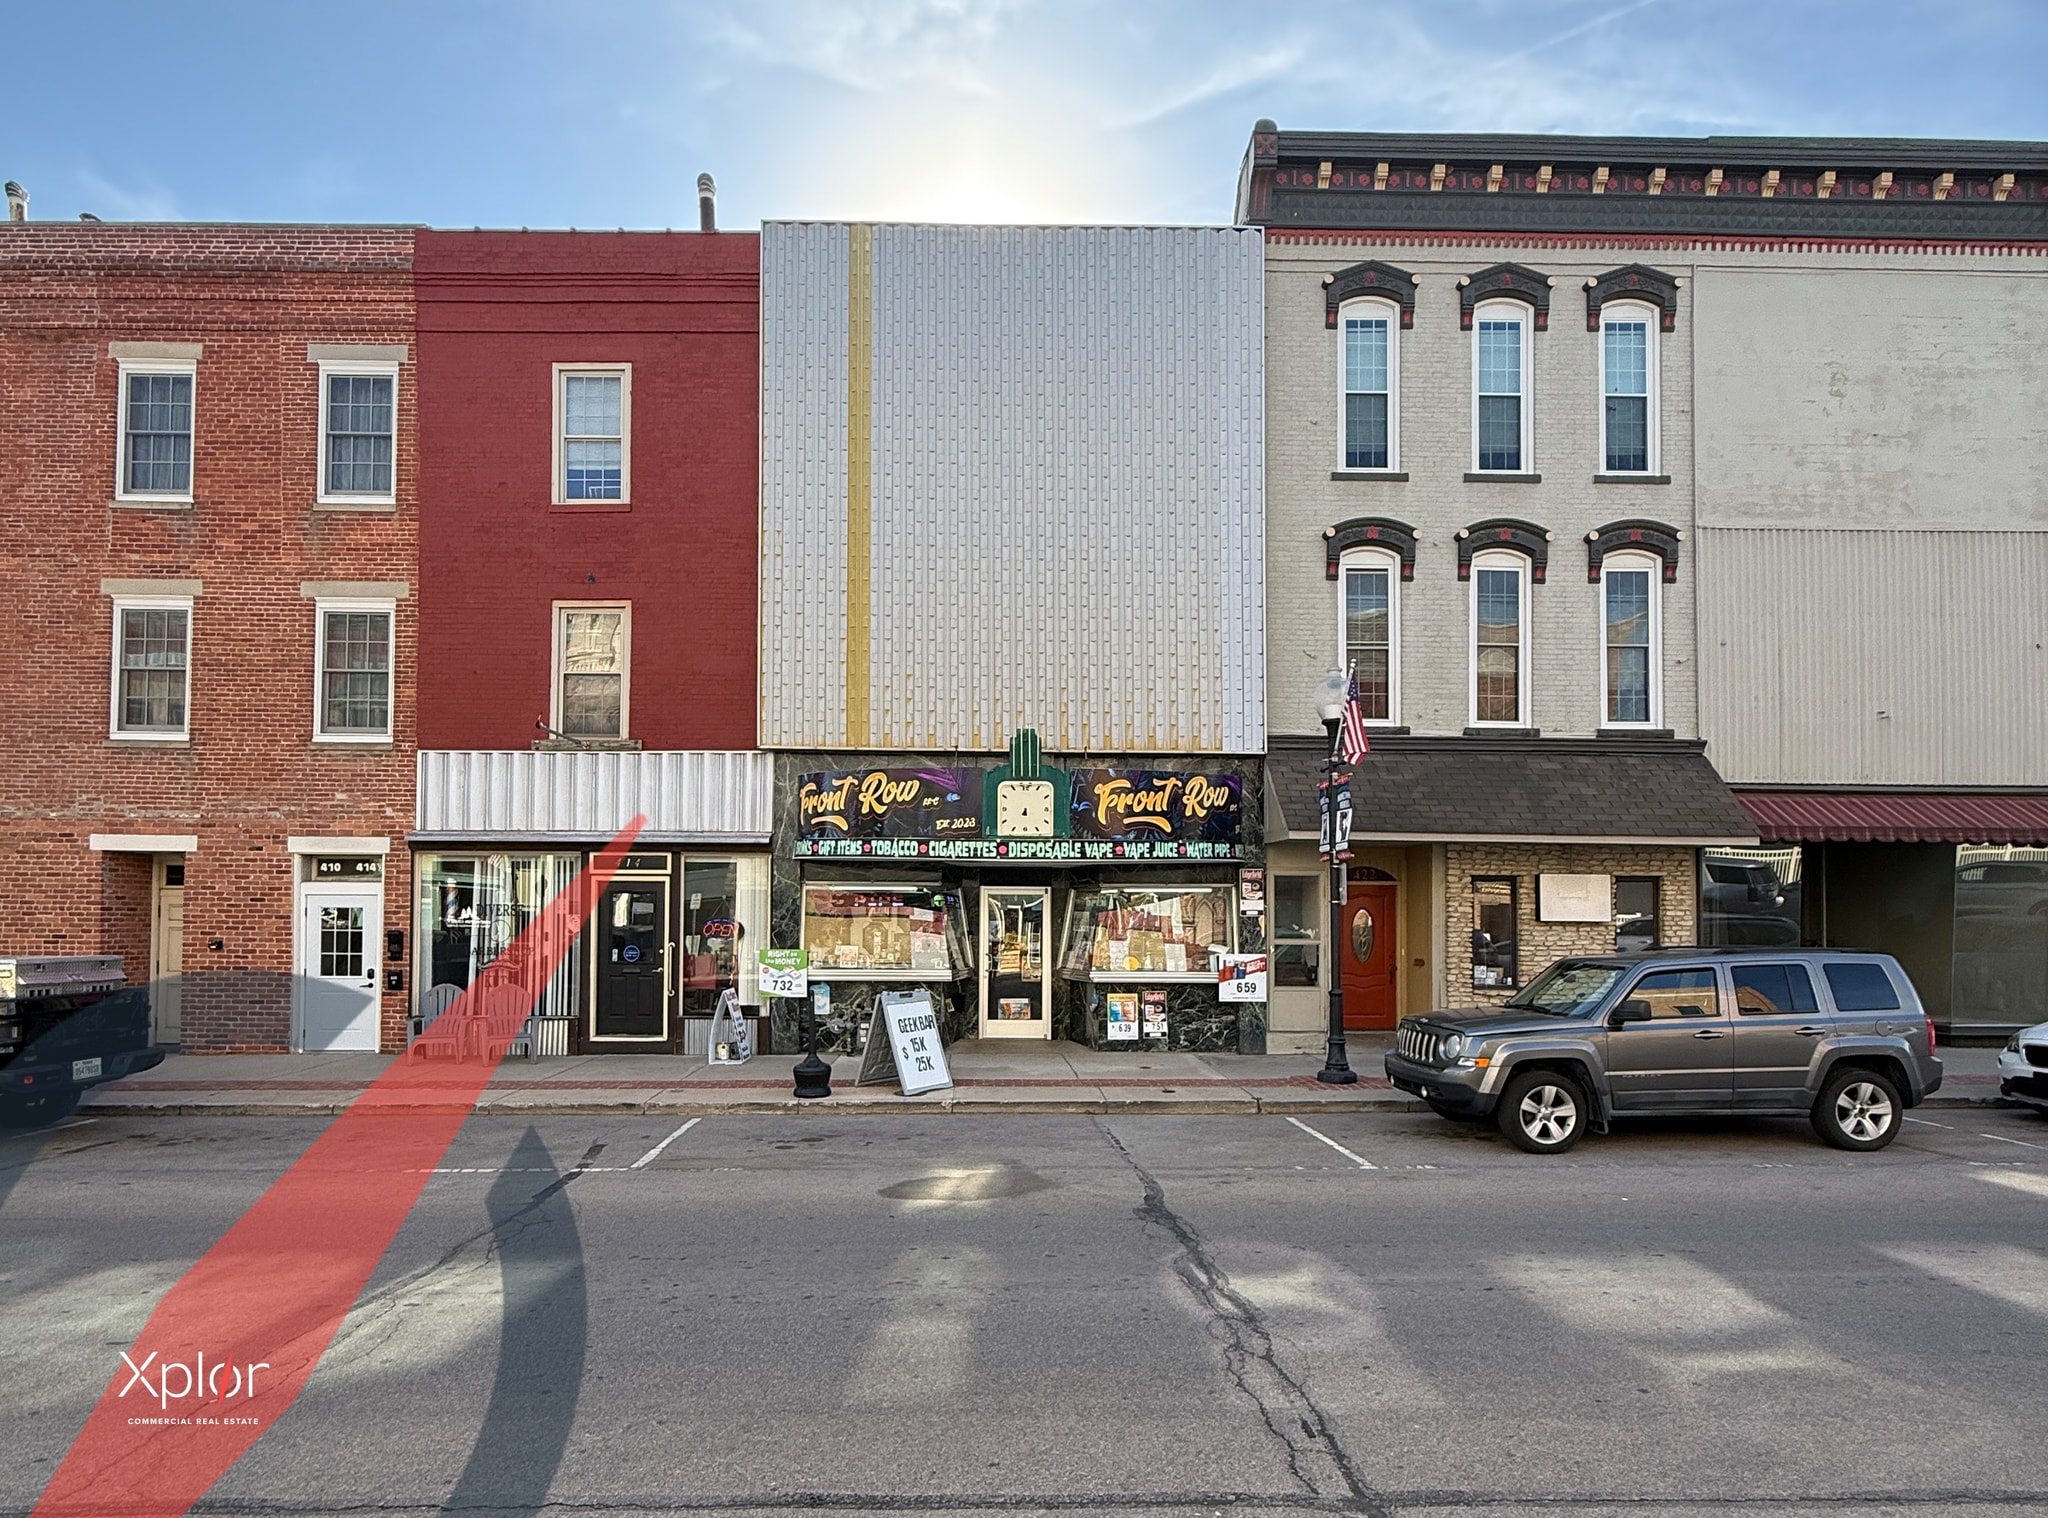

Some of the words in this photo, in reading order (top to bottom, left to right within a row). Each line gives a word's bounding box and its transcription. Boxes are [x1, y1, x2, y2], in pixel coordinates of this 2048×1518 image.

[800, 775, 859, 826] Front
[859, 772, 921, 814] Row
[1094, 776, 1183, 826] Front
[1183, 775, 1230, 818] Row
[951, 817, 976, 830] 2023
[818, 840, 837, 857] GIFT
[837, 839, 863, 856] ITEMS
[871, 839, 919, 857] TOBACCO
[929, 840, 997, 859] CIGARETTES
[1008, 840, 1081, 860] DISPOSABLE
[1084, 842, 1113, 860] VAPE
[1122, 842, 1150, 860] VAPE
[1153, 842, 1178, 858] JUICE
[1186, 841, 1214, 859] WATER
[1214, 842, 1231, 858] PIPE
[320, 862, 341, 872] 410
[703, 923, 738, 937] OPEN
[775, 957, 802, 965] MONEY
[772, 980, 793, 991] 732
[1236, 982, 1257, 993] 659
[898, 1016, 920, 1034] GEEK
[919, 1014, 936, 1031] BAR
[1118, 1023, 1132, 1033] 639
[910, 1036, 928, 1053] 15K
[902, 1046, 909, 1061] $
[915, 1055, 935, 1072] 25K
